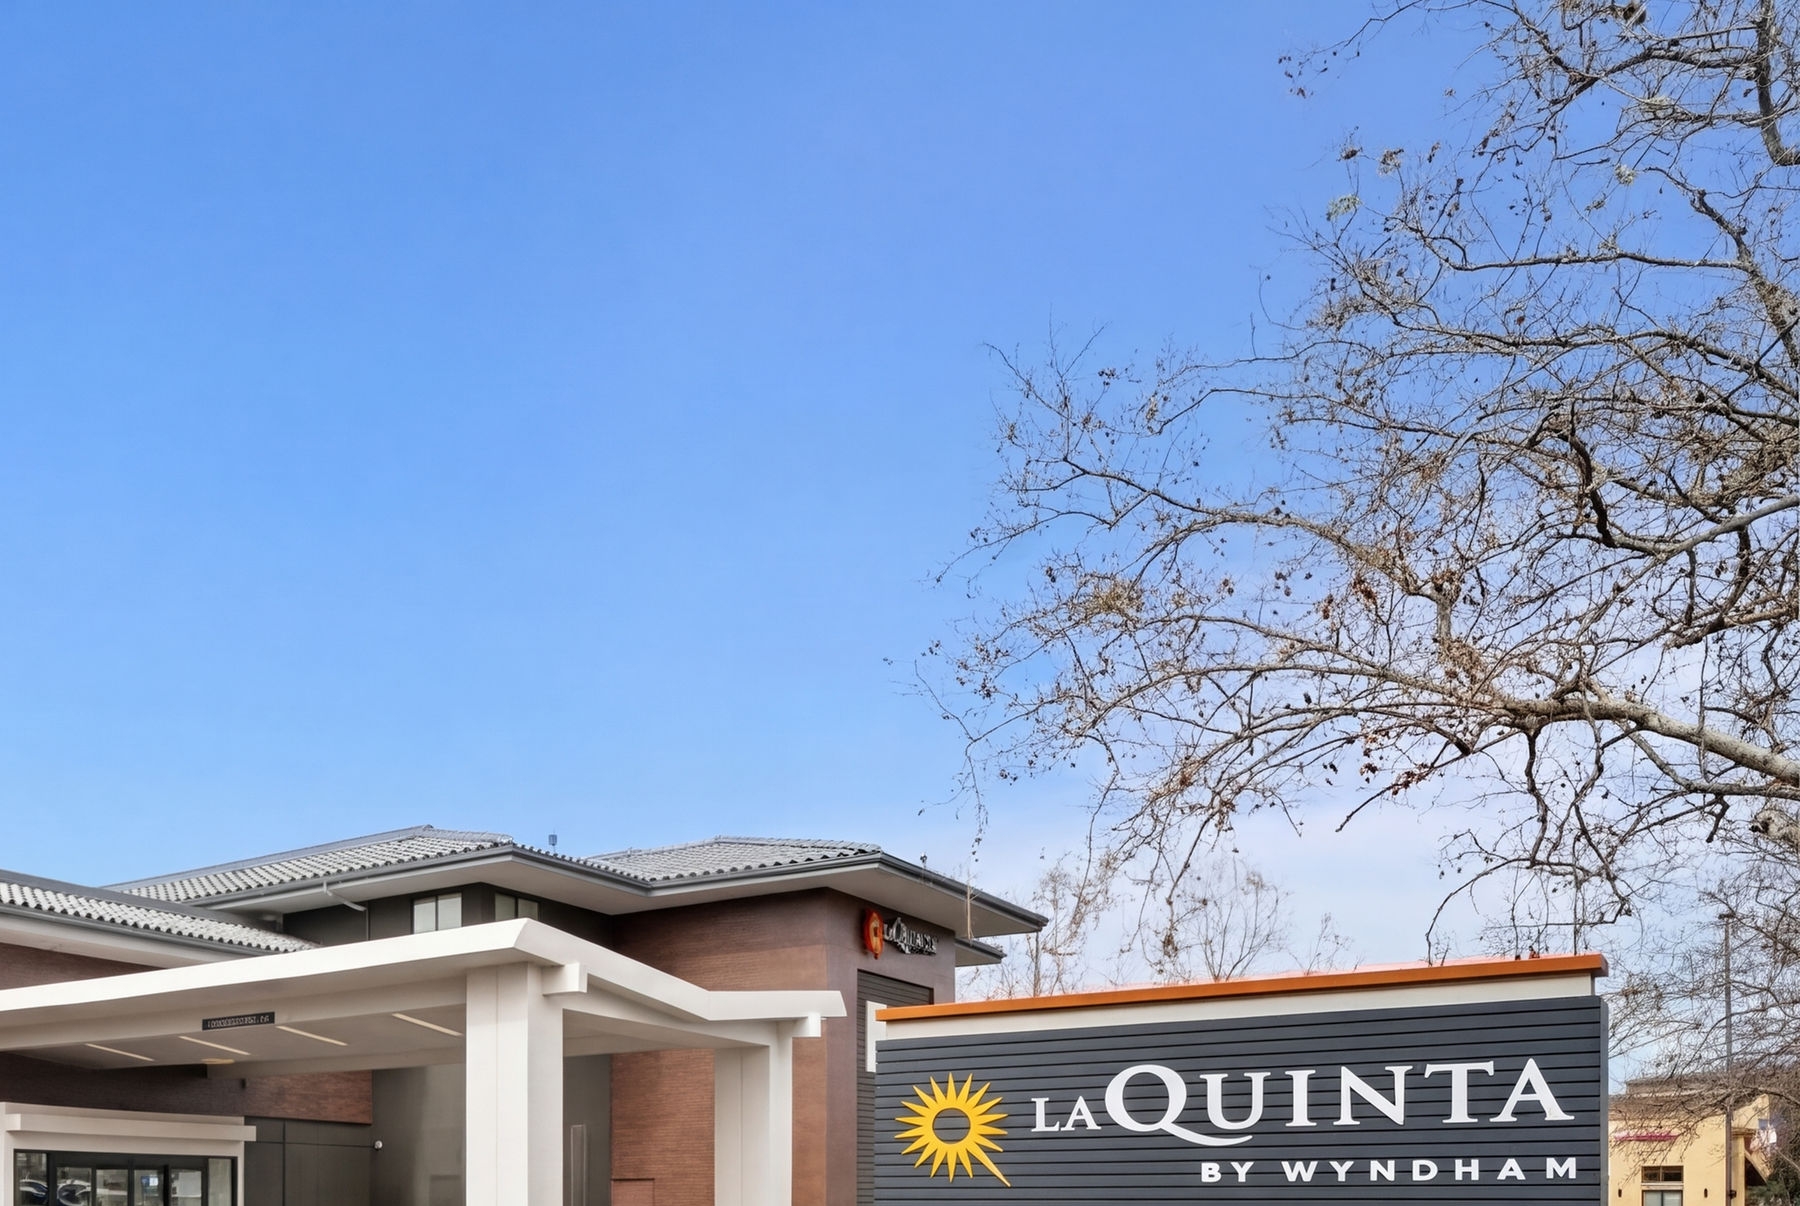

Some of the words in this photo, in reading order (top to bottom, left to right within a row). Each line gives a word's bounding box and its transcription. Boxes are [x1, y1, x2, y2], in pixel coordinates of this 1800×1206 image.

[1031, 1096, 1101, 1132] LA
[1105, 1058, 1574, 1146] QUINTA
[1202, 1160, 1254, 1182] BY
[1281, 1157, 1576, 1181] WYNDHAM
